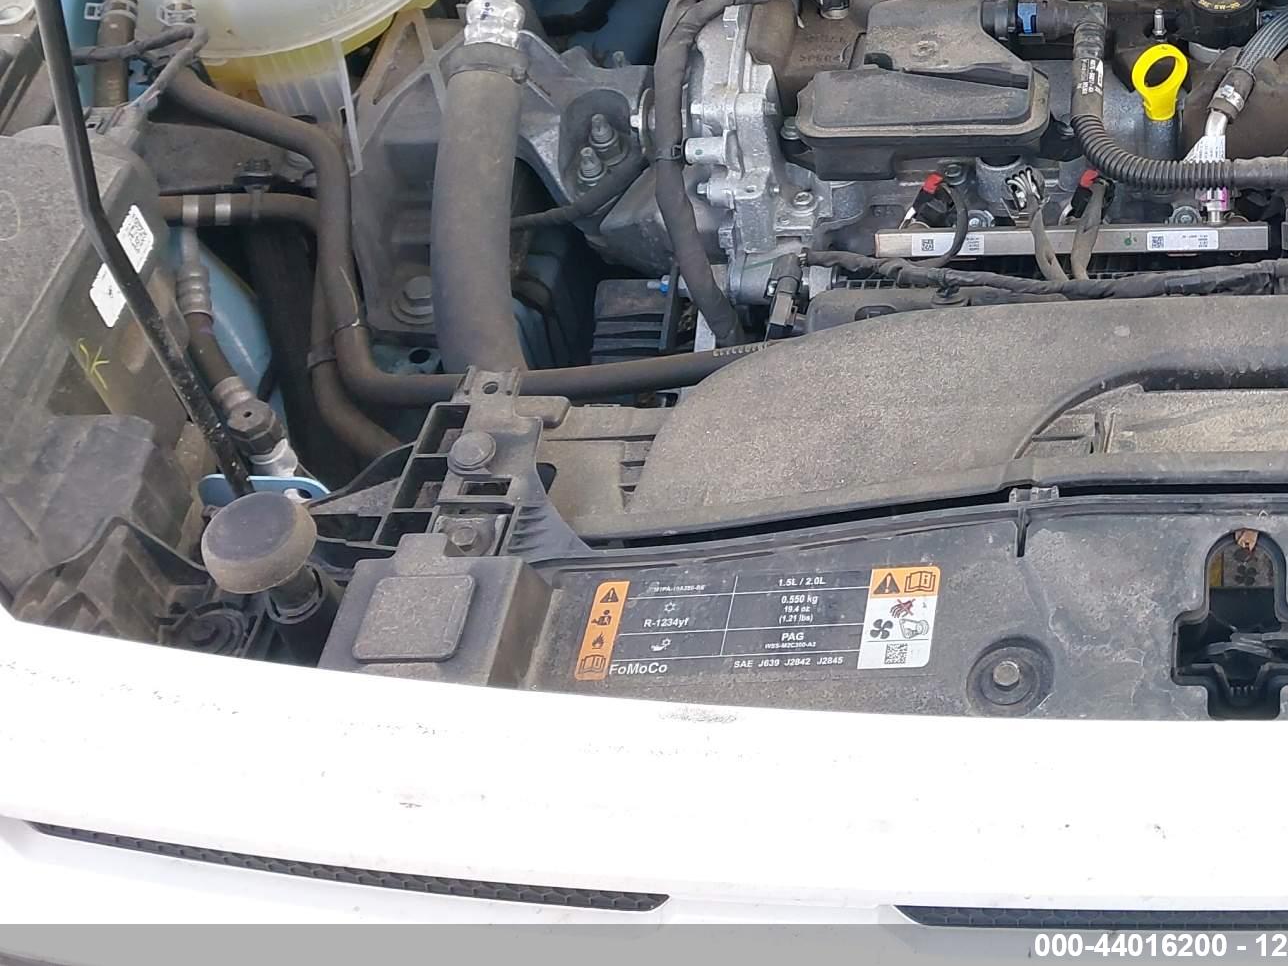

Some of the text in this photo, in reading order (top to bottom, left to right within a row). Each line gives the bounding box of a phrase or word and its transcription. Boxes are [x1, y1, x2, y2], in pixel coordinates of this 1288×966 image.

[779, 578, 798, 587] 1.5L
[804, 576, 826, 586] 2.0L
[781, 594, 819, 605] 0.550 kg
[784, 605, 800, 613] 19.4
[643, 617, 690, 628] R-1234yf
[778, 614, 798, 625] (1.21
[780, 632, 804, 642] PAG
[734, 656, 844, 668] SAE J639 J2842 J2845
[609, 662, 668, 675] FoMoCo
